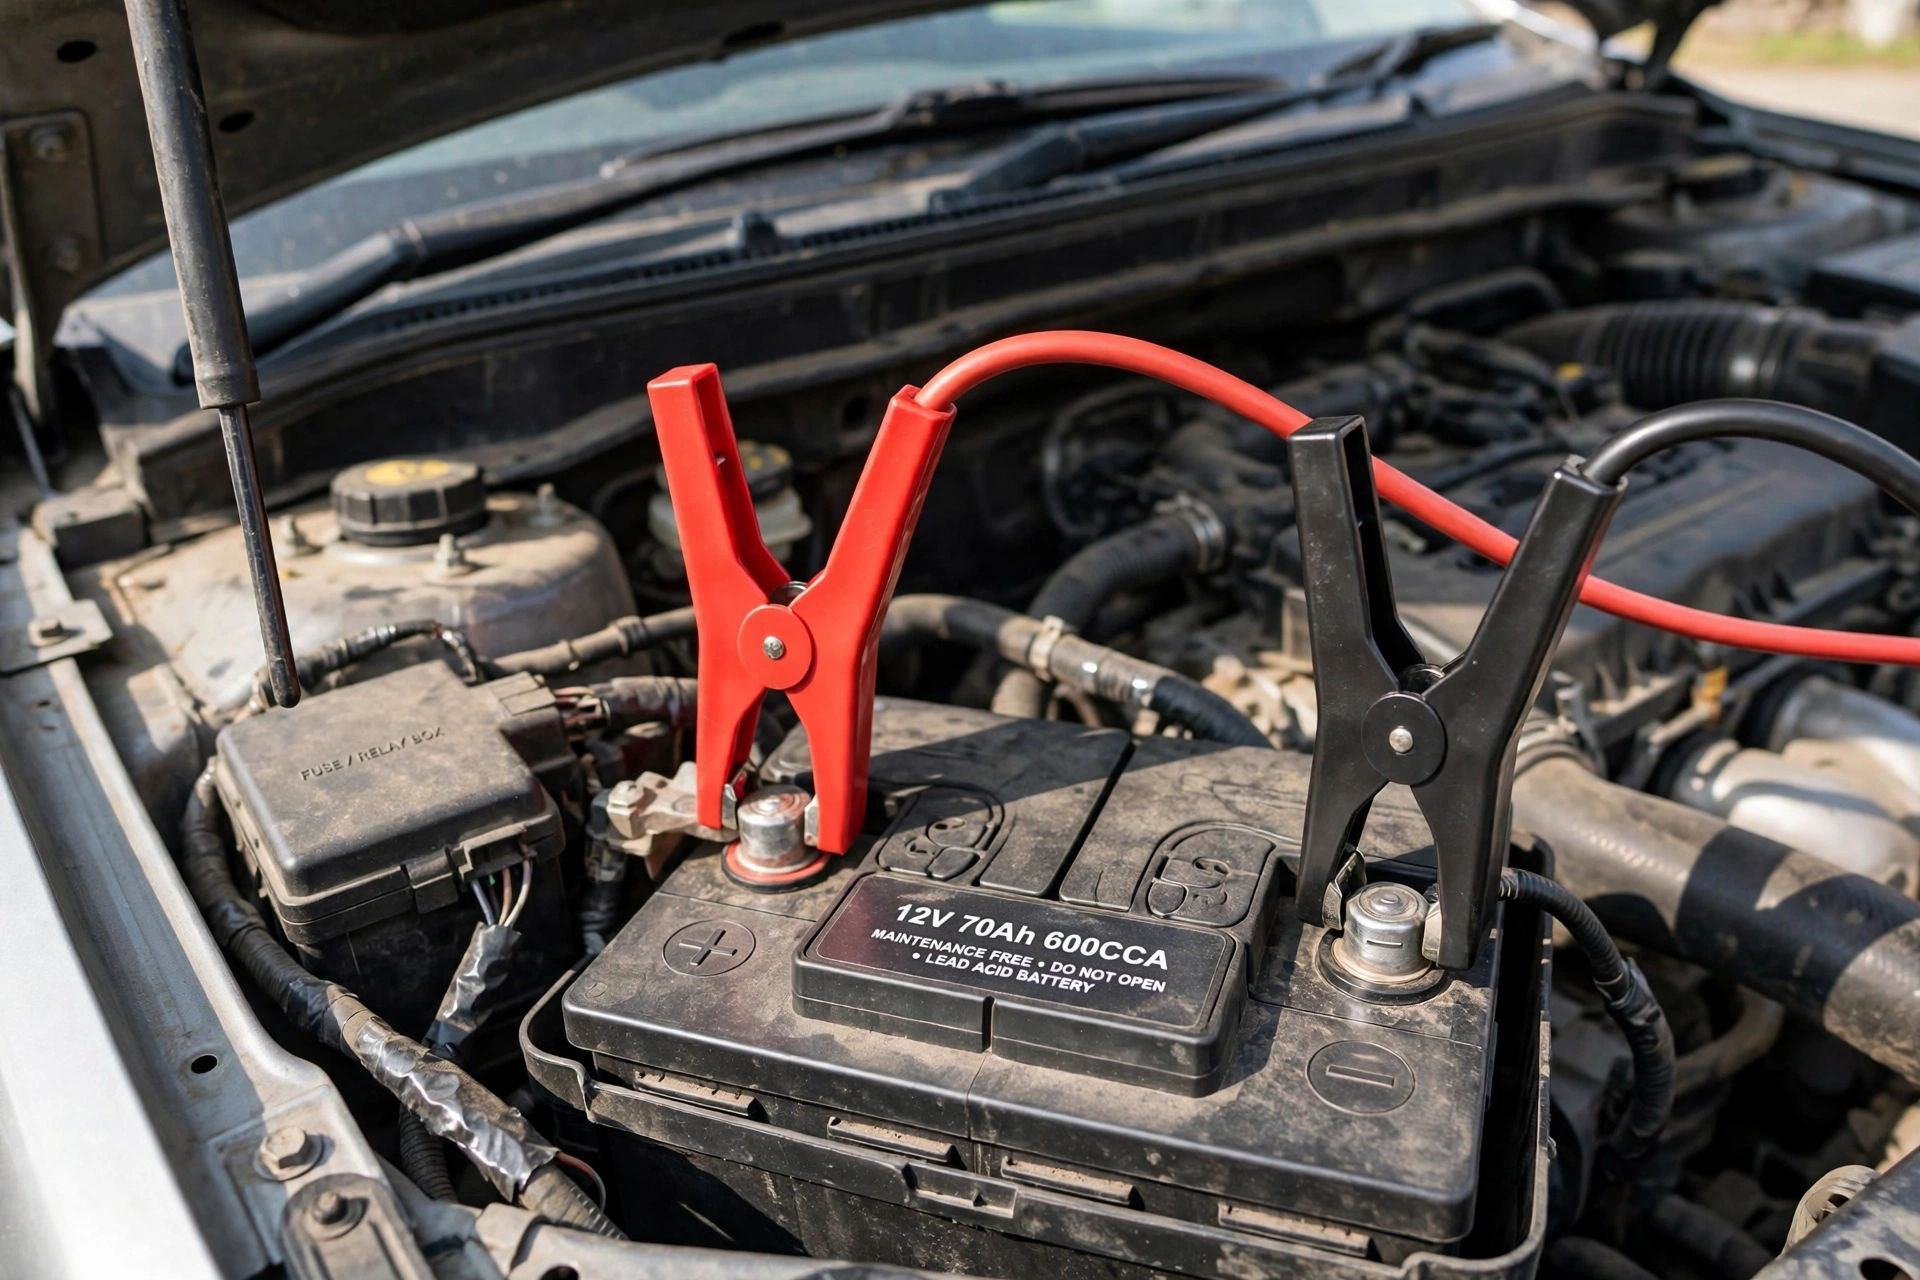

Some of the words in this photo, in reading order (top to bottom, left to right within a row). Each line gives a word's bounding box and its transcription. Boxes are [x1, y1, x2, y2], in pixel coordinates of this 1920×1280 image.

[300, 759, 343, 781] FUSE
[358, 737, 406, 762] RELAY
[411, 727, 446, 745] BOX
[871, 929, 988, 958] MAINTENANCE
[989, 950, 1032, 968] FREE
[1050, 961, 1076, 976] DO
[1078, 965, 1117, 983] NOT
[1117, 974, 1167, 993] OPEN
[897, 904, 955, 928] 12V
[959, 915, 1036, 946] 70Ah
[1043, 931, 1169, 970] 600CCA
[925, 953, 970, 973] LEAD
[970, 961, 1016, 979] ACID
[1016, 969, 1096, 994] BATTERY
